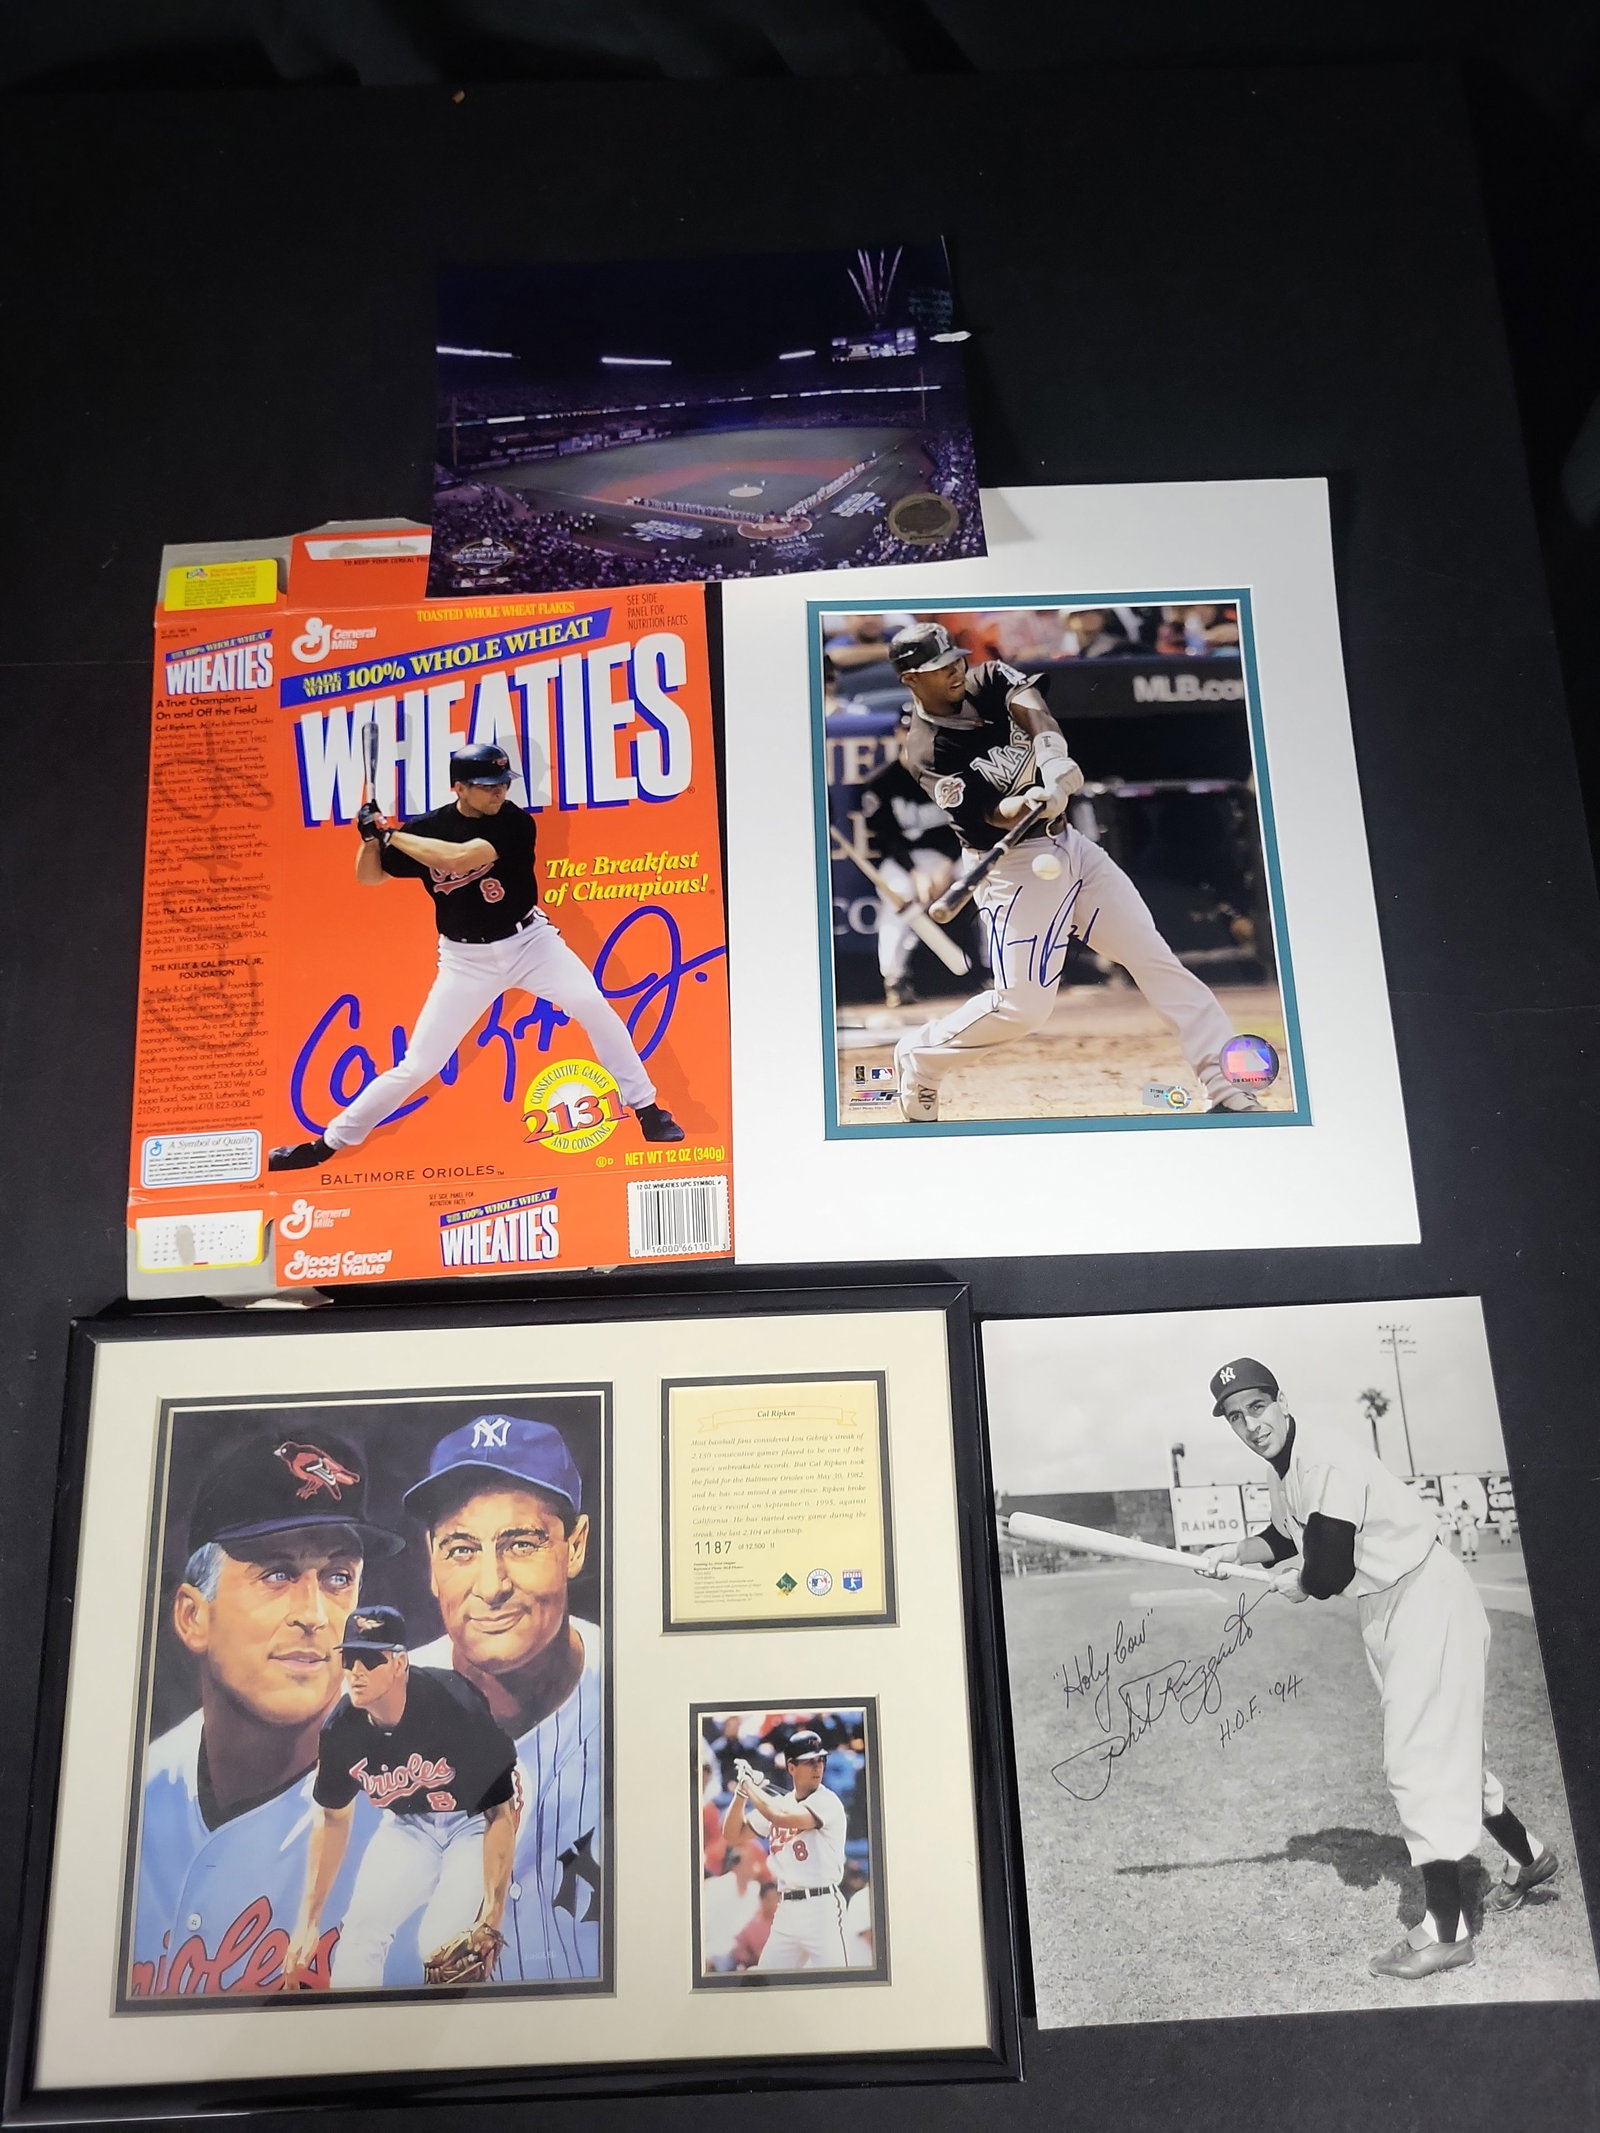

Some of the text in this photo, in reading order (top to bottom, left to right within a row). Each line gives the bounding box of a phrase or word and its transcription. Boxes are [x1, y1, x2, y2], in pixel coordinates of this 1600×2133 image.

[626, 593, 657, 605] SEE SIDE
[416, 602, 575, 622] TOASTED WHOLE WHEAT FLAKES
[627, 605, 665, 618] PANEL FOR
[628, 615, 688, 631] NUTRITION FACTS
[332, 627, 377, 640] General
[303, 671, 342, 689] MADE
[346, 661, 405, 690] 100%
[410, 638, 502, 676] WHOLE
[504, 616, 593, 654] WHEAT
[331, 640, 359, 650] Mills
[166, 642, 274, 696] WHEATIES
[1132, 674, 1245, 702] MLB.co
[156, 695, 241, 708] A True Champion
[156, 704, 258, 720] On and Off the Field
[296, 632, 693, 827] WHEATIES
[545, 850, 700, 880] The Breakfast
[479, 877, 505, 903] 8
[543, 873, 709, 908] of Champions!
[152, 964, 165, 972] THE
[201, 961, 216, 969] CAL
[180, 970, 235, 979] FOUNDATION
[530, 1064, 610, 1105] CONSECUTIVE GAMES
[521, 1089, 631, 1144] 2131
[551, 1126, 611, 1151] AND COUNTING
[625, 1145, 725, 1166] NET WT 12 OZ (340g)
[314, 1208, 351, 1219] General
[462, 1208, 483, 1220] 100%
[484, 1199, 518, 1215] WHOLE
[518, 1191, 552, 1206] WHEAT
[440, 1204, 559, 1267] WHEATIES
[342, 1249, 393, 1265] Cereal
[652, 1245, 679, 1254] 16000
[681, 1243, 710, 1252] 66110
[341, 1263, 386, 1277] Value
[757, 1409, 796, 1419] Cal Ripken
[694, 1540, 732, 1555] 1187
[427, 1791, 457, 1811] 8
[792, 1840, 808, 1861] 8
